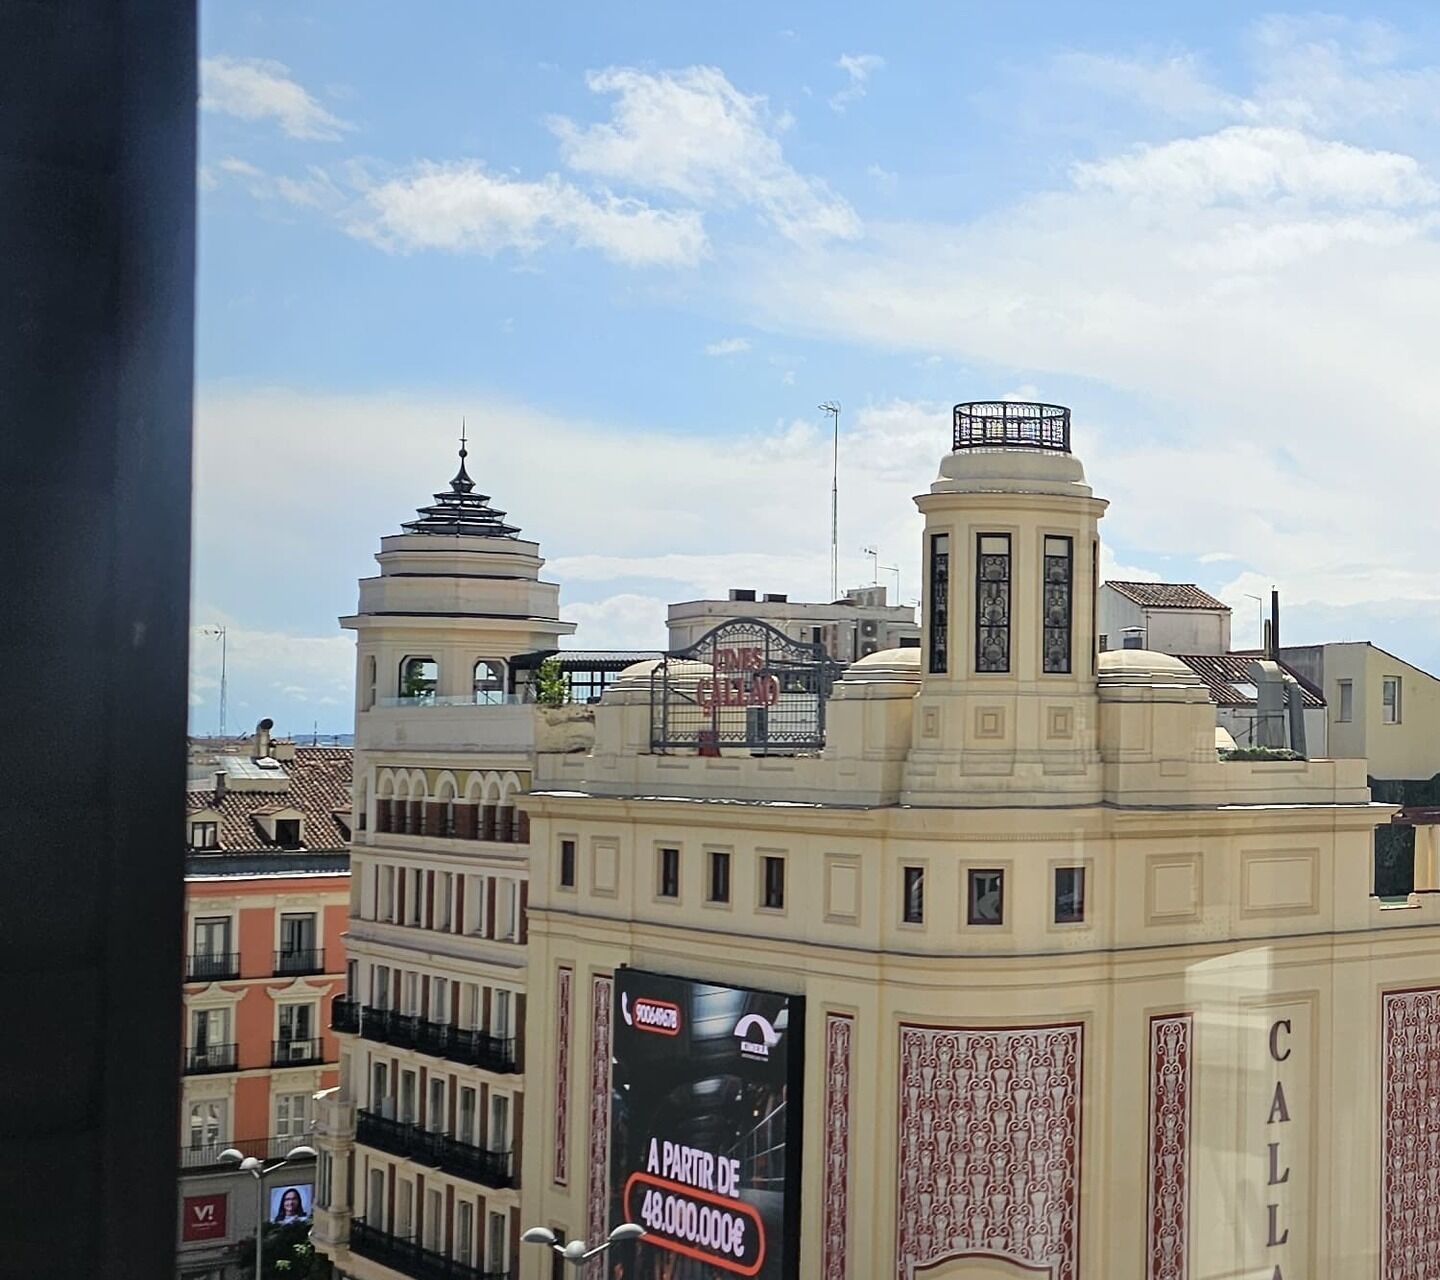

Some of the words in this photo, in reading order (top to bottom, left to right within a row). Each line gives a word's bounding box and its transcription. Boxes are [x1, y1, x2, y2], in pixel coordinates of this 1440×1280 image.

[647, 1137, 660, 1174] A
[717, 1156, 740, 1198] DE
[641, 1190, 745, 1257] 48.000.000€
